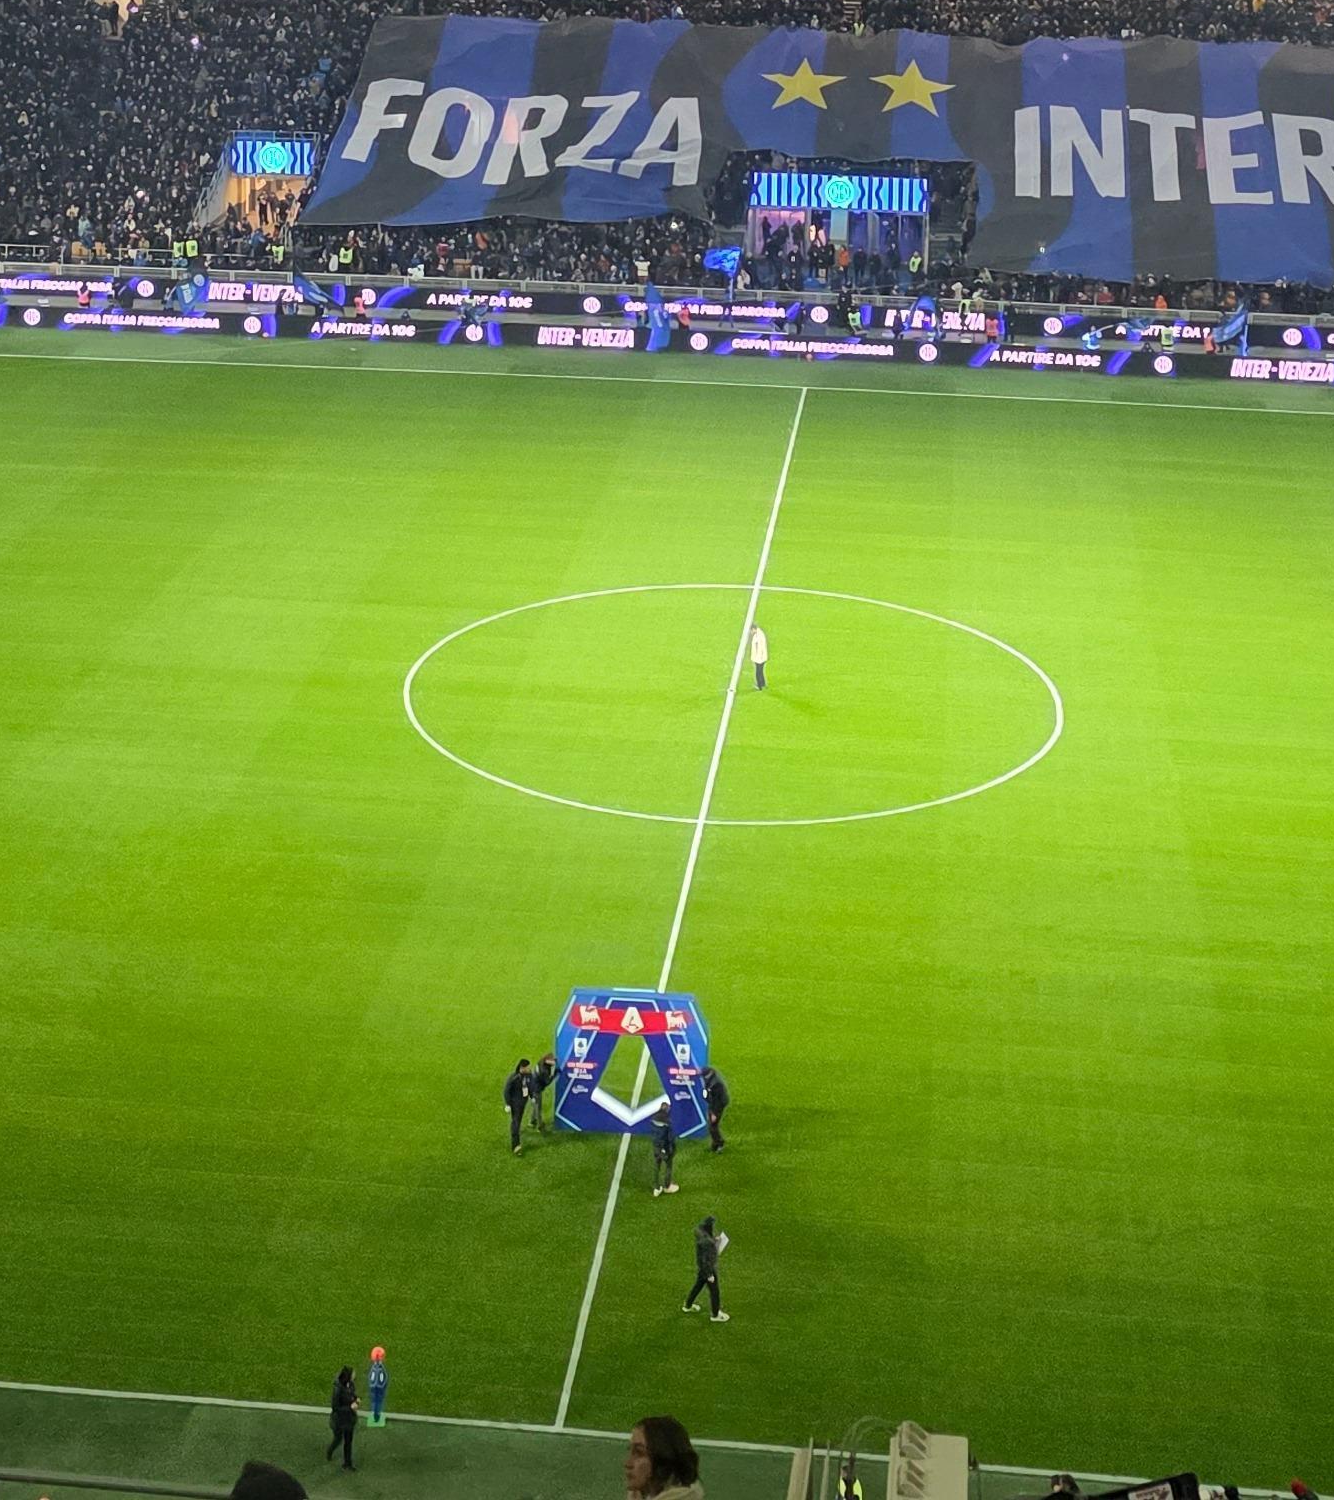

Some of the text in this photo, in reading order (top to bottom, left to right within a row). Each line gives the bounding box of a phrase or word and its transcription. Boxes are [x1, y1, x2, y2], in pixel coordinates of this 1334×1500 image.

[342, 76, 701, 187] FORZA
[426, 293, 437, 305] A
[489, 296, 507, 308] DA
[311, 322, 322, 334] A
[322, 322, 371, 336] PARTIRE
[372, 324, 390, 336] DA
[1182, 326, 1202, 339] DA
[989, 349, 1002, 362] A
[1003, 350, 1053, 366] PARTIRE
[1054, 353, 1074, 366] DA
